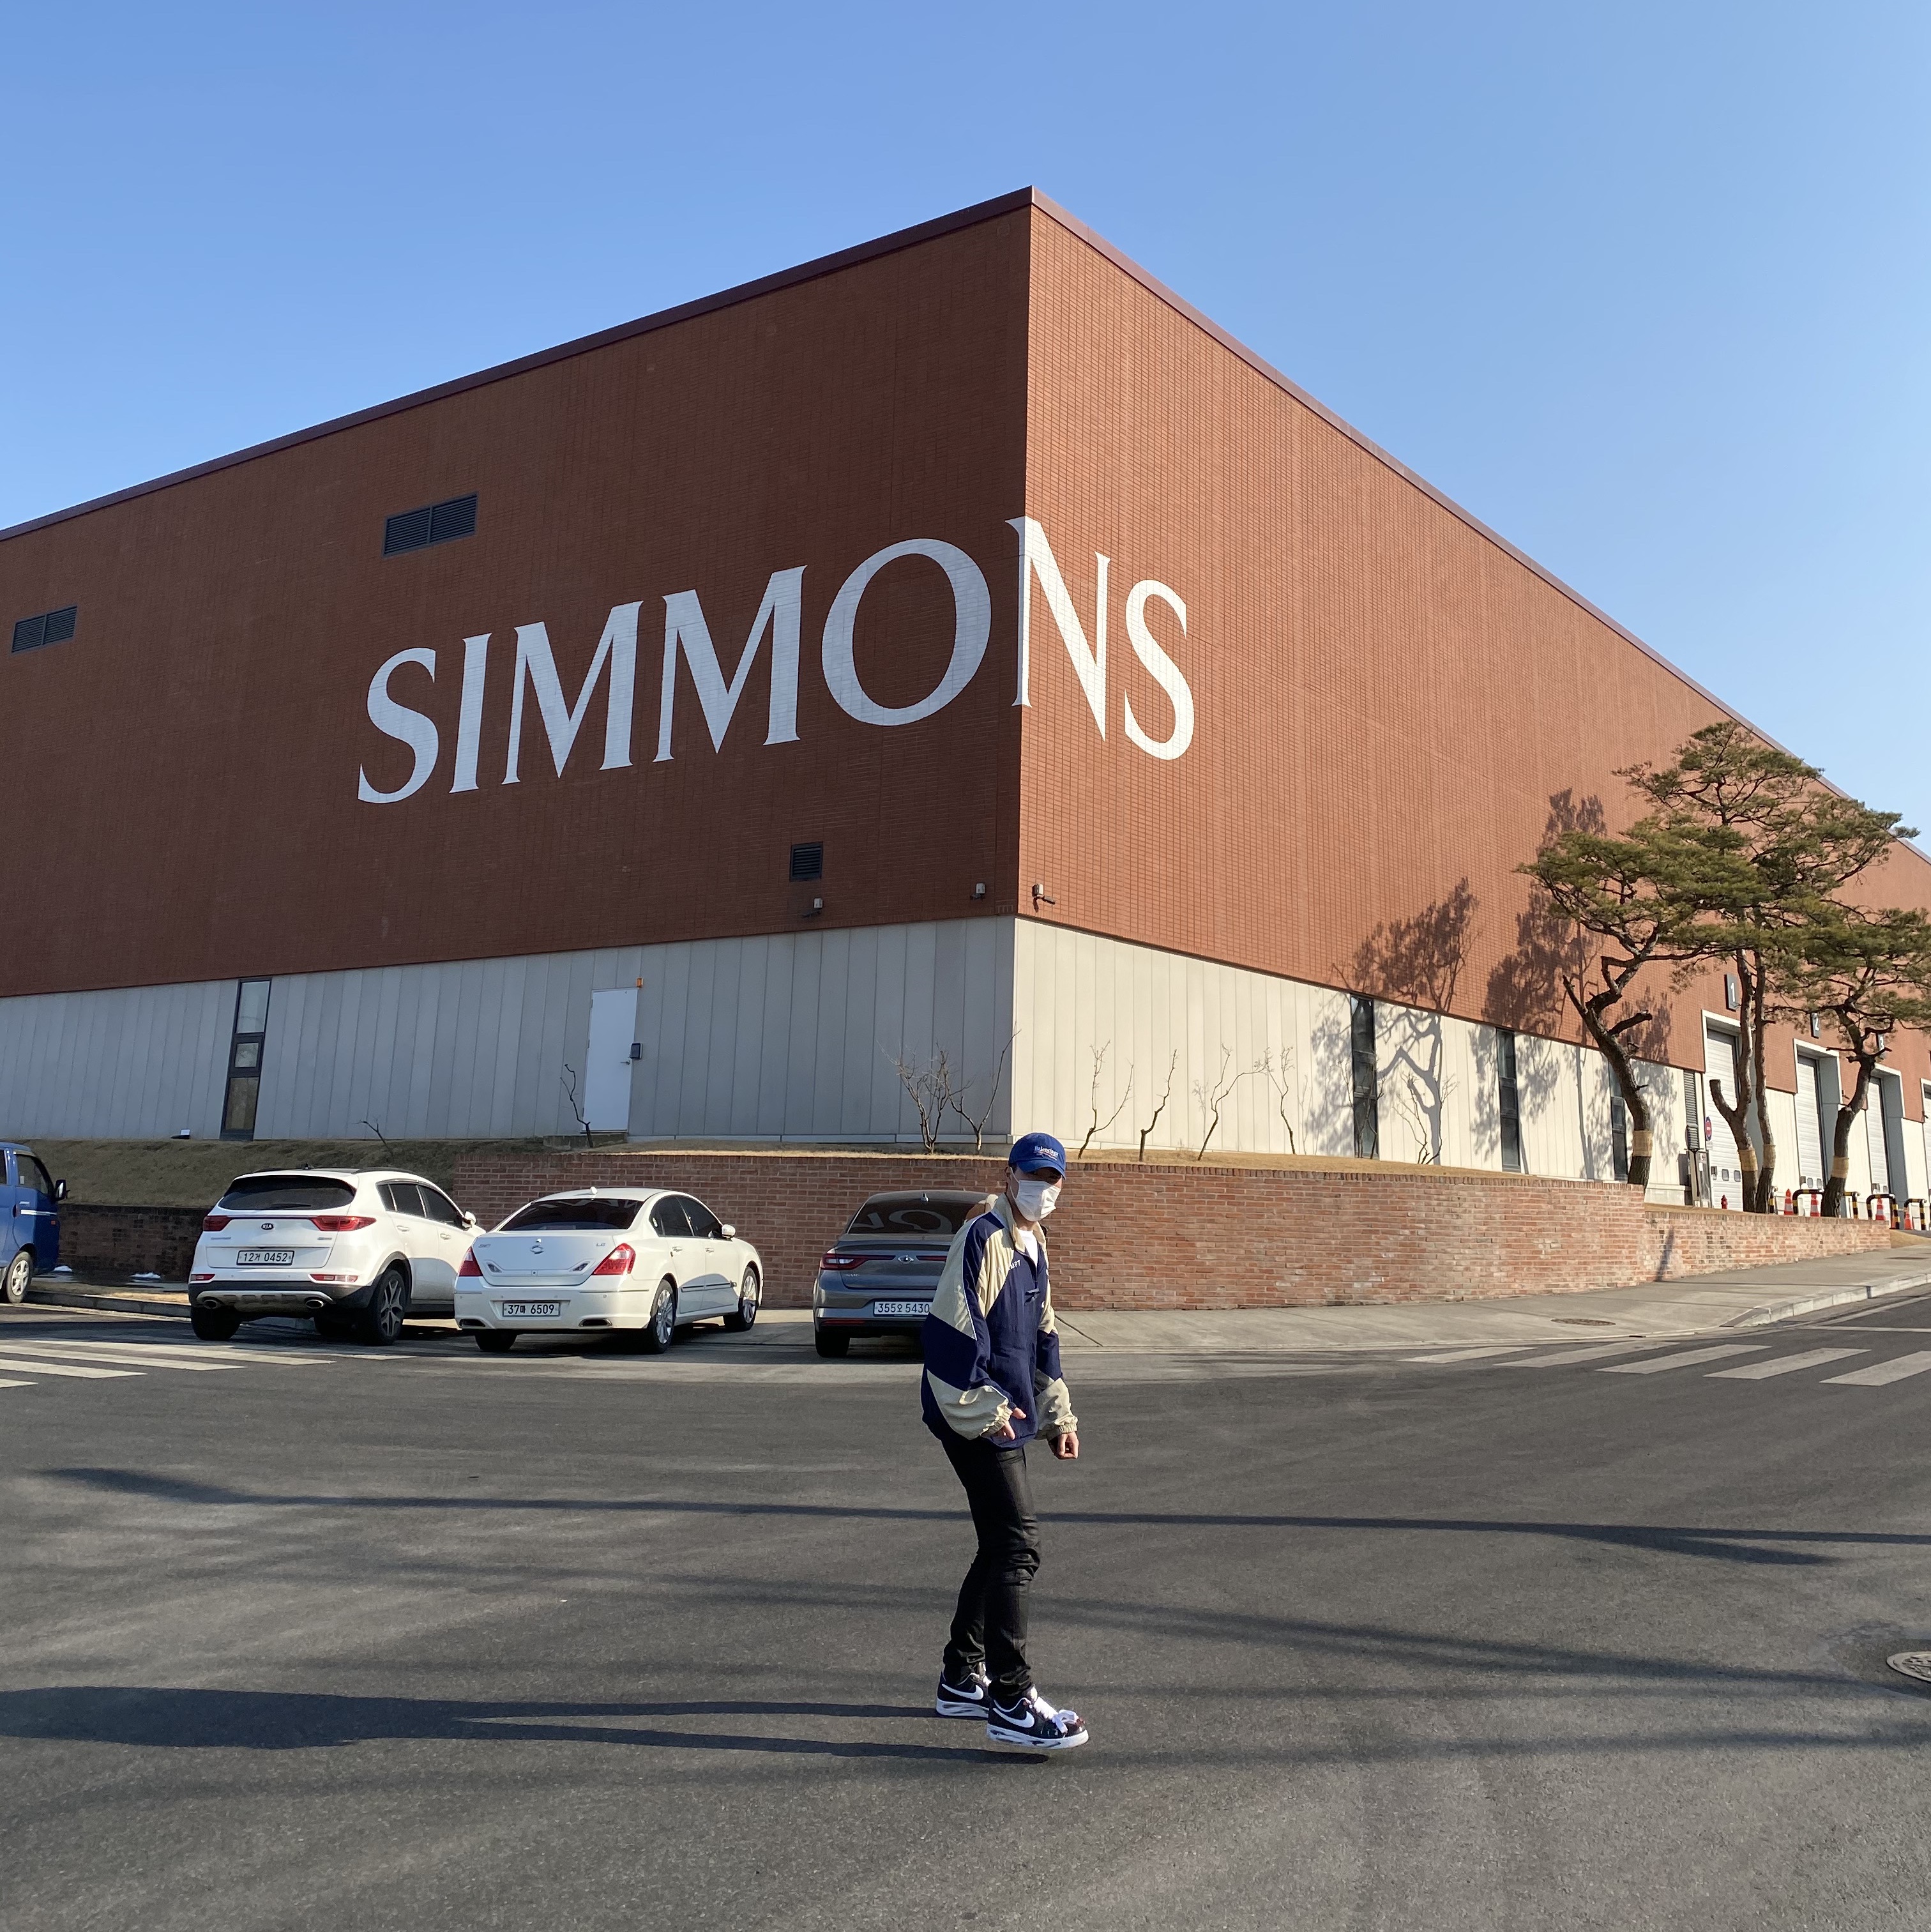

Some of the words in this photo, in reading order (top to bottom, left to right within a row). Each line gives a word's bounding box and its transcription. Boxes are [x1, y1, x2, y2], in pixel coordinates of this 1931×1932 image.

[358, 515, 1195, 803] SIMMONS
[1730, 982, 1735, 1002] 1
[264, 1252, 288, 1262] 0452
[508, 1304, 526, 1314] 37마
[531, 1304, 554, 1314] 6509
[877, 1303, 903, 1312] 355오
[905, 1303, 930, 1313] 5430
